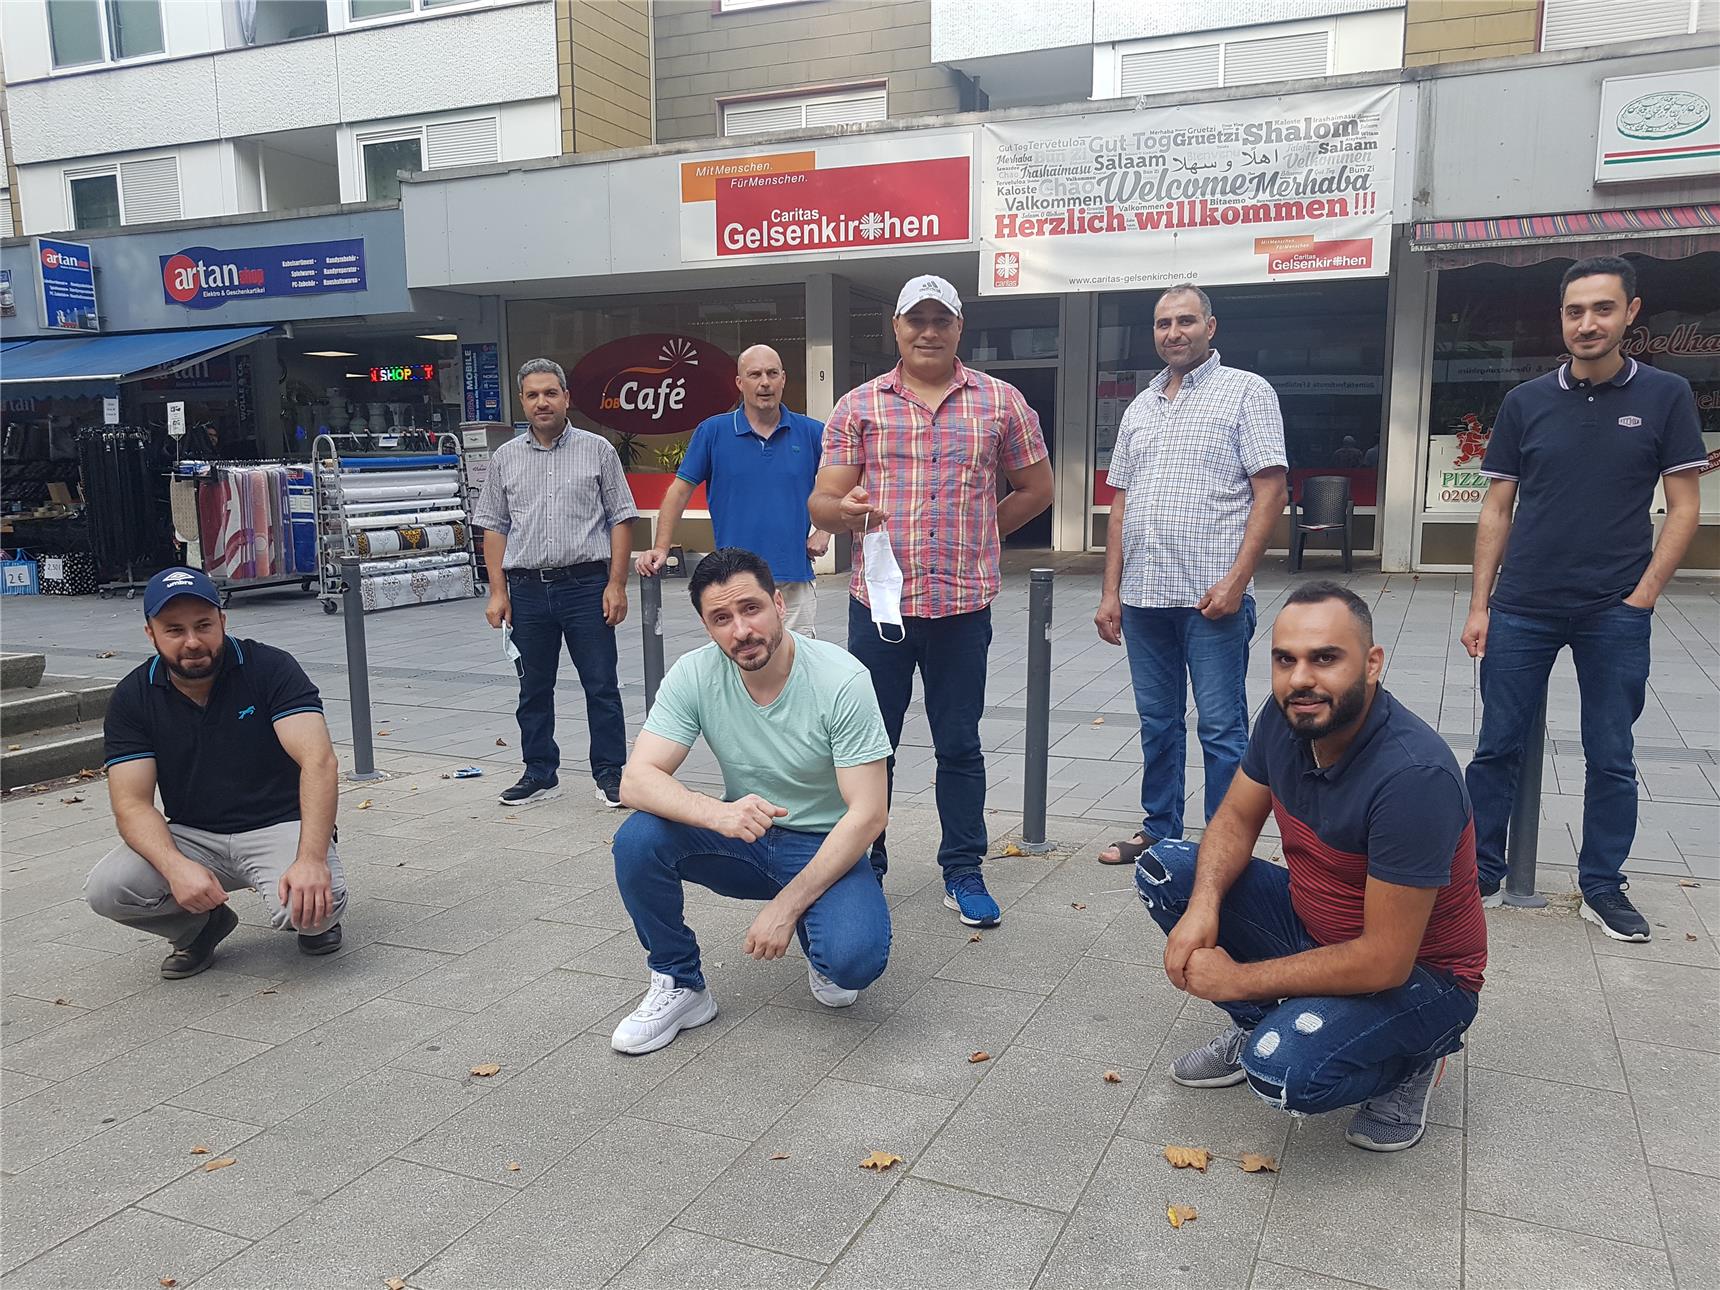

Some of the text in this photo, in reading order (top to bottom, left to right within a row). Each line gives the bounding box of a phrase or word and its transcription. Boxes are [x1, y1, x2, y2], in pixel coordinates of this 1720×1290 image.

[1172, 129, 1240, 147] Gruetzi
[1187, 126, 1216, 134] Gruetzi
[1242, 117, 1359, 146] Shalom
[998, 143, 1028, 152] Gut Tog
[1028, 138, 1086, 150] Tervetuloa
[1089, 132, 1171, 153] Gut Tog
[1318, 140, 1378, 155] Salaam
[996, 153, 1033, 164] Merhaba
[1094, 153, 1166, 171] Salaam
[1171, 157, 1217, 174] سهلا
[1219, 160, 1233, 172] و
[1349, 165, 1375, 174] Bun Zi
[997, 185, 1037, 196] Kaloste
[1040, 178, 1095, 197] Chao
[1096, 168, 1250, 205] Welcome
[1248, 165, 1372, 200] Merhaba
[1005, 195, 1103, 211] Valkommen
[1119, 204, 1165, 212] Valkommen
[771, 208, 820, 224] Caritas
[995, 205, 1126, 239] Herzlich
[723, 210, 940, 251] Gelsenkirhen
[47, 253, 78, 266] artan
[1272, 256, 1367, 271] Gelsenkirhen
[174, 259, 240, 290] artan
[1069, 271, 1198, 285] www.caritas-gelsenkirchen.de
[380, 368, 412, 381] SHOP
[464, 349, 474, 390] MOBILE
[819, 370, 825, 382] 9
[619, 377, 687, 420] Café
